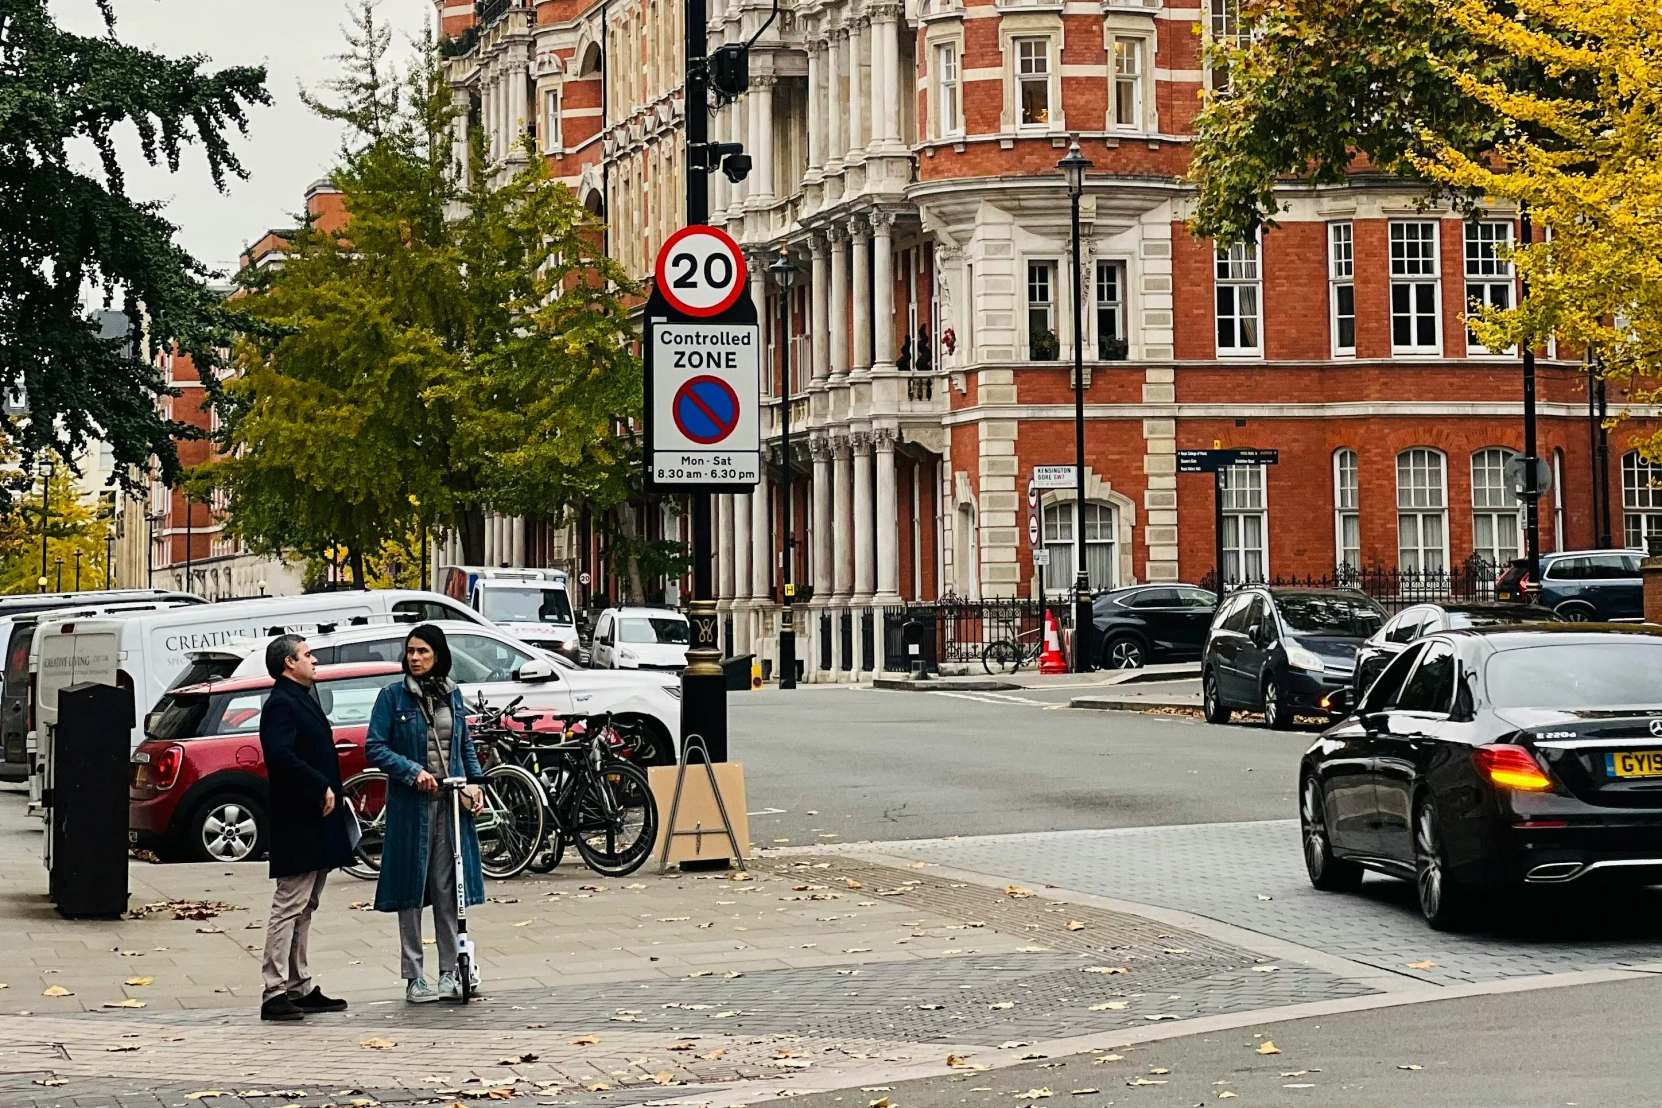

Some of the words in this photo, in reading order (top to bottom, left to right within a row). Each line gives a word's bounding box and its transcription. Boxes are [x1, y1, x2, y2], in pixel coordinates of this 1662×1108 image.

[672, 253, 733, 289] 20
[660, 330, 751, 346] Controlled
[673, 351, 738, 369] ZONE
[681, 456, 704, 466] Mon
[713, 456, 731, 466] Sat
[657, 469, 684, 479] 8.30
[686, 471, 702, 479] am
[710, 469, 736, 479] 6.30
[738, 471, 755, 480] pm
